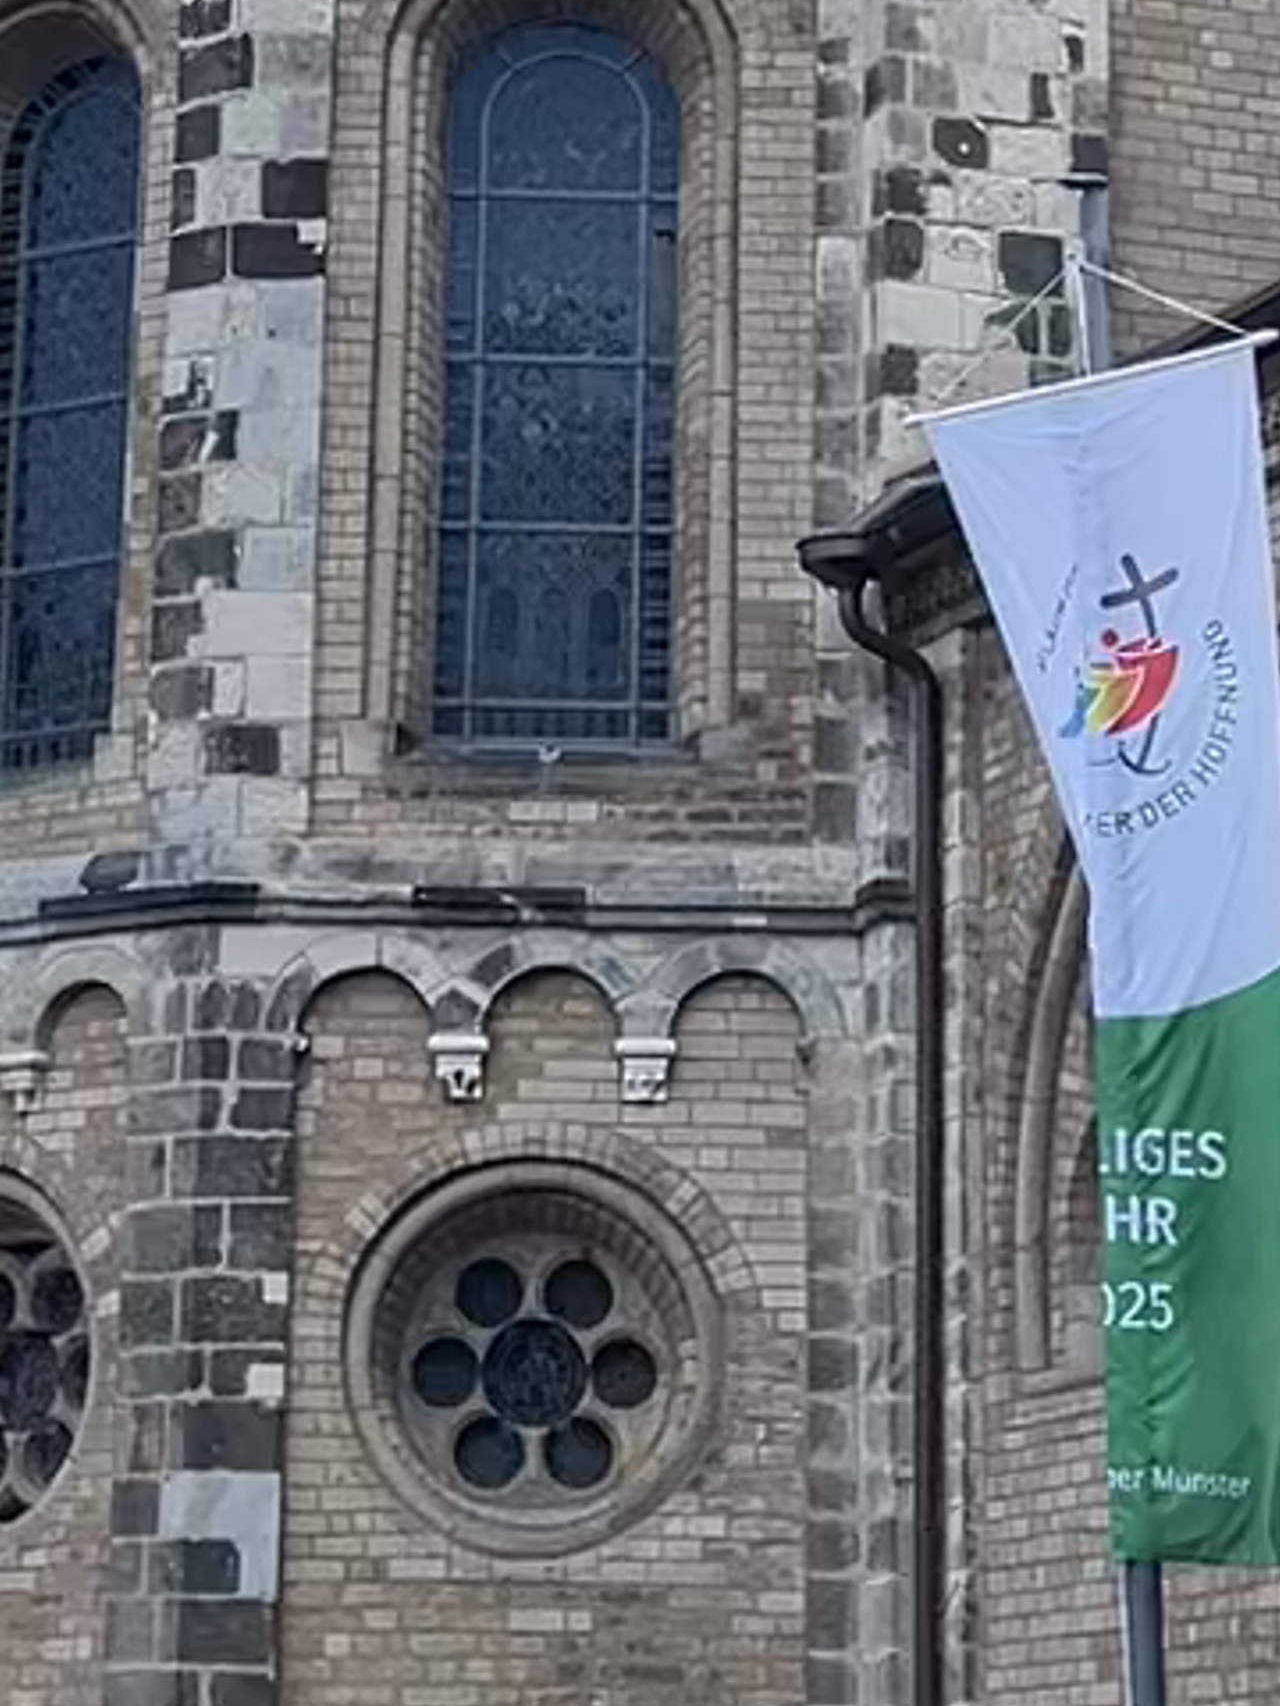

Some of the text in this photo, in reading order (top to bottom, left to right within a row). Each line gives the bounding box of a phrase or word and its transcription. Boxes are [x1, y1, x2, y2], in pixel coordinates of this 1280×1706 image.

[1086, 619, 1239, 838] ER DER HOFFNUNG
[1098, 1127, 1227, 1180] IGES
